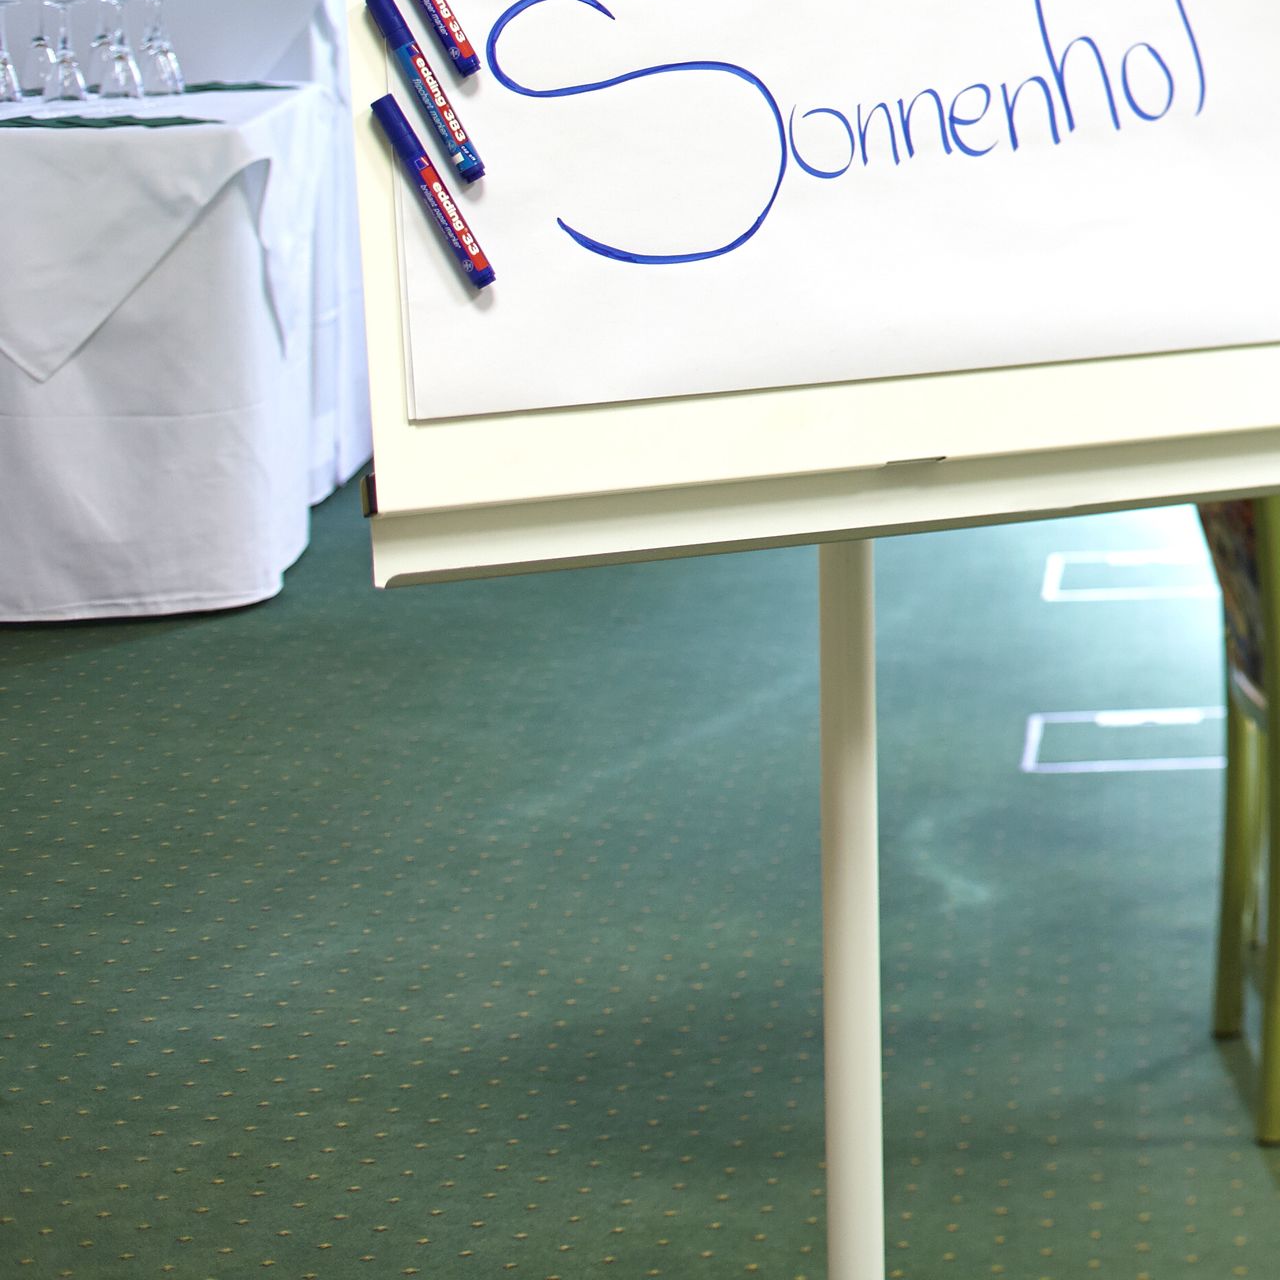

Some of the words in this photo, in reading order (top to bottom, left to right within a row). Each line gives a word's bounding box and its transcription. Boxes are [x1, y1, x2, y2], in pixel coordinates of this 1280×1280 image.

[432, 14, 448, 36] marker
[449, 20, 466, 43] 33
[416, 57, 447, 108] edding
[443, 109, 466, 142] 383
[432, 181, 464, 231] edding
[462, 233, 479, 256] 33
[433, 208, 448, 227] paper
[444, 226, 461, 249] marker
